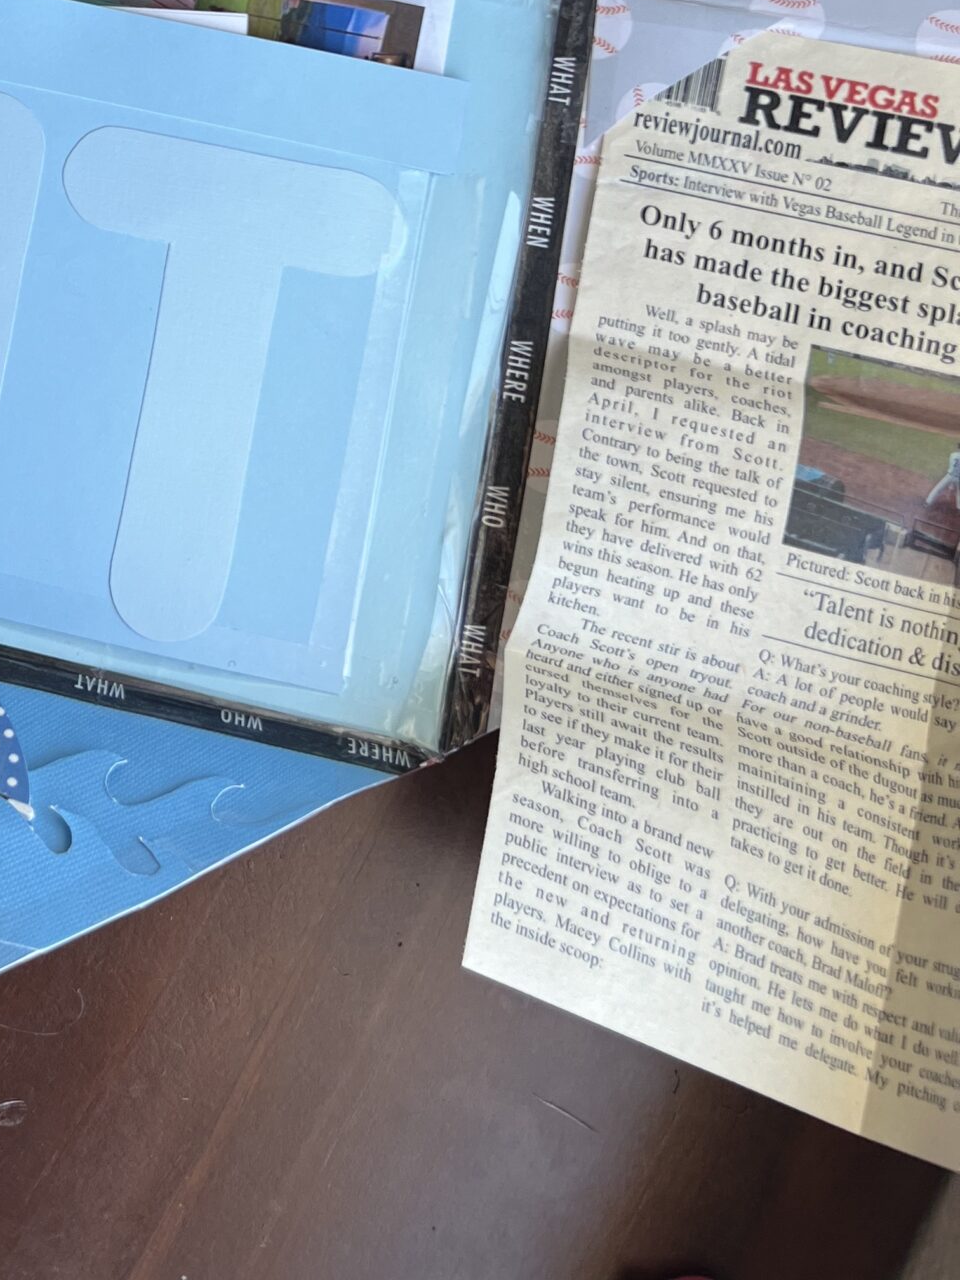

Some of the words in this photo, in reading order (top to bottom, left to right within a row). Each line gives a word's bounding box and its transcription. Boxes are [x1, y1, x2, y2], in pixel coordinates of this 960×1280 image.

[548, 57, 577, 106] WHAT
[745, 62, 814, 96] LAS
[820, 75, 940, 119] VEGAS
[633, 111, 802, 160] reviewjournal.com
[636, 138, 685, 162] Volume
[687, 149, 752, 174] MMXXV
[753, 162, 789, 184] Issue
[814, 175, 832, 192] 02
[526, 197, 556, 248] WHEN
[629, 163, 680, 187] Sports:
[682, 175, 746, 200] Interview
[748, 192, 779, 208] with
[782, 195, 821, 217] Vegas
[824, 204, 883, 229] Baseball
[885, 216, 938, 240] Legend
[940, 228, 955, 243] in
[639, 204, 700, 238] Only
[708, 219, 722, 240] 6
[730, 228, 825, 262] months
[832, 250, 864, 273] in,
[873, 259, 924, 283] and
[643, 237, 685, 265] has
[693, 254, 762, 282] made
[770, 267, 810, 292] the
[817, 275, 910, 314] biggest
[916, 302, 960, 326] spl
[596, 315, 646, 337] putting
[651, 327, 663, 338] it
[667, 329, 691, 344] too
[694, 337, 740, 357] gently.
[746, 346, 758, 360] A
[764, 351, 796, 368] tidal
[645, 303, 679, 325] Well,
[684, 316, 694, 327] a
[698, 319, 741, 338] splash
[746, 330, 776, 347] may
[781, 334, 799, 350] be
[696, 282, 800, 325] baseball
[807, 306, 832, 332] in
[840, 320, 957, 362] coaching
[502, 340, 534, 404] WHERE
[589, 376, 617, 390] and
[624, 384, 674, 405] parents
[683, 398, 720, 417] alike.
[730, 407, 766, 428] Back
[775, 422, 790, 434] in
[581, 427, 641, 455] Contrary
[645, 445, 660, 458] to
[664, 447, 703, 472] being
[708, 459, 730, 476] the
[734, 468, 760, 485] talk
[765, 476, 782, 490] of
[481, 485, 510, 528] WHO
[565, 518, 595, 540] they
[600, 526, 634, 548] have
[639, 538, 703, 566] delivered
[708, 559, 738, 576] with
[744, 566, 763, 582] 62
[785, 551, 850, 581] Pictured:
[853, 569, 891, 592] Scott
[892, 579, 925, 601] back
[927, 592, 941, 604] in
[803, 589, 874, 624] “Talent
[878, 613, 894, 629] is
[899, 618, 959, 646] nothin
[803, 620, 903, 662] dedication
[907, 646, 926, 667] &
[458, 624, 486, 678] WHAT
[74, 673, 126, 700] WHAT
[221, 708, 263, 732] WHO
[347, 737, 411, 768] WHERE
[489, 910, 512, 930] the
[514, 919, 556, 948] inside
[558, 942, 603, 969] scoop:
